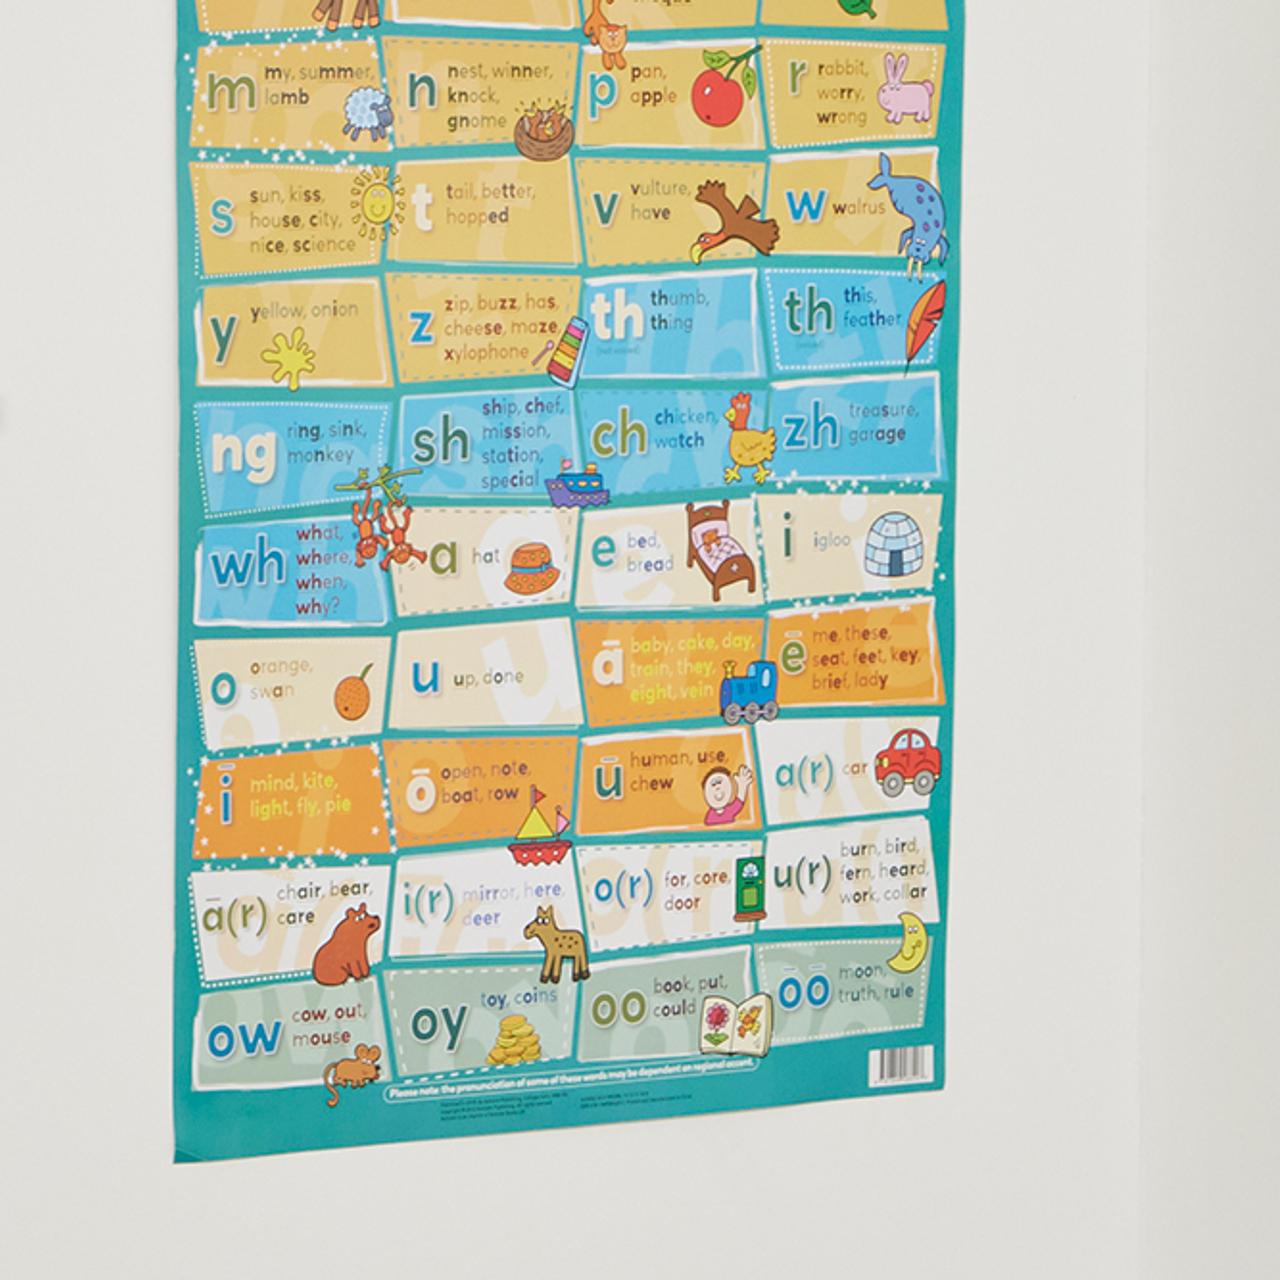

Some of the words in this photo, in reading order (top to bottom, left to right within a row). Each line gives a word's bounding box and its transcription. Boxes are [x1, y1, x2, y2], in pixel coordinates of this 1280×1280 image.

[264, 66, 295, 82] my,
[300, 64, 376, 80] summer,
[448, 64, 488, 80] nest,
[492, 64, 554, 79] winner,
[631, 64, 667, 82] pan,
[790, 60, 808, 94] r
[818, 60, 869, 78] rabbit,
[208, 72, 256, 109] m
[266, 89, 309, 105] lamb
[409, 72, 436, 108] n
[448, 88, 500, 104] knock,
[589, 71, 617, 120] p
[631, 88, 677, 107] apple
[818, 86, 866, 104] worry,
[448, 114, 506, 132] gnome
[817, 109, 867, 128] wrong
[250, 188, 284, 204] sun,
[290, 186, 325, 204] kiss,
[446, 183, 477, 201] tail,
[482, 182, 536, 200] better,
[631, 181, 691, 198] vulture,
[411, 182, 432, 231] t
[592, 191, 619, 226] v
[631, 203, 671, 221] have
[786, 190, 826, 221] w
[832, 200, 886, 216] walrus
[211, 198, 234, 235] s
[309, 211, 342, 229] city,
[446, 207, 509, 227] hopped
[292, 237, 356, 254] science
[444, 298, 473, 314] zip,
[525, 296, 559, 311] has,
[651, 290, 709, 308] thumb,
[844, 287, 878, 305] this,
[251, 303, 308, 324] yellow,
[311, 301, 359, 318] onion
[590, 288, 644, 340] th
[784, 284, 833, 334] th
[409, 311, 433, 343] z
[651, 315, 693, 333] thing
[844, 310, 901, 328] feather
[209, 316, 237, 364] y
[444, 344, 529, 364] xylophone
[482, 401, 521, 419] ship,
[524, 399, 565, 416] chef,
[655, 408, 718, 426] chicken,
[849, 402, 919, 418] treasure,
[329, 421, 368, 439] sink,
[482, 422, 551, 441] mission,
[592, 406, 648, 456] ch
[782, 400, 839, 449] zh
[413, 412, 469, 464] sh
[656, 432, 704, 449] watch
[849, 426, 906, 446] garage
[211, 431, 277, 484] ng
[288, 448, 354, 465] monkey
[482, 448, 544, 465] station,
[482, 473, 539, 491] special
[296, 524, 344, 543] what,
[628, 531, 662, 551] bed,
[782, 511, 792, 559] i
[814, 531, 851, 551] igloo
[296, 549, 352, 566] where,
[430, 540, 458, 574] a
[472, 547, 501, 564] hat
[591, 534, 617, 568] e
[209, 534, 285, 588] wh
[628, 554, 674, 573] bread
[296, 574, 348, 591] when,
[296, 599, 340, 616] why?
[630, 636, 674, 654] baby,
[678, 634, 719, 651] cake,
[722, 632, 756, 650] day,
[251, 658, 314, 677] orange,
[412, 662, 439, 693] u
[454, 671, 479, 689] up,
[483, 669, 524, 685] done
[812, 672, 850, 689] brief,
[854, 671, 888, 689] lady
[211, 671, 238, 706] o
[251, 683, 294, 699] swan
[630, 684, 678, 704] eight,
[681, 682, 714, 698] vein
[630, 751, 693, 768] human,
[698, 750, 729, 764] use,
[842, 761, 868, 776] car
[441, 764, 486, 781] open,
[491, 761, 531, 777] note,
[776, 754, 834, 793] a(r)
[250, 774, 299, 794] mind,
[304, 772, 338, 790] kite,
[630, 774, 673, 792] chew
[441, 786, 484, 803] boat,
[488, 787, 519, 800] row
[841, 841, 881, 858] burn,
[885, 838, 920, 855] bird,
[665, 871, 691, 889] for,
[694, 870, 731, 886] core,
[774, 854, 832, 894] u(r)
[840, 864, 875, 881] fern,
[879, 861, 929, 879] heard,
[330, 881, 373, 896] bear,
[462, 885, 520, 901] mirror,
[524, 882, 565, 899] here,
[594, 868, 654, 908] o(r)
[840, 888, 879, 904] work,
[884, 884, 927, 900] collar
[404, 882, 454, 924] i(r)
[665, 895, 700, 911] door
[277, 909, 315, 925] care
[462, 909, 501, 926] deer
[839, 965, 888, 979] moon,
[653, 975, 695, 995] book,
[699, 971, 729, 992] put,
[481, 992, 511, 1009] toy,
[515, 988, 558, 1005] coins
[839, 988, 881, 1003] truth,
[884, 984, 914, 999] rule
[335, 1004, 368, 1021] out,
[592, 992, 646, 1027] oo
[653, 999, 696, 1019] could
[412, 1006, 467, 1051] oy
[207, 1020, 282, 1059] ow
[292, 1030, 351, 1048] mouse
